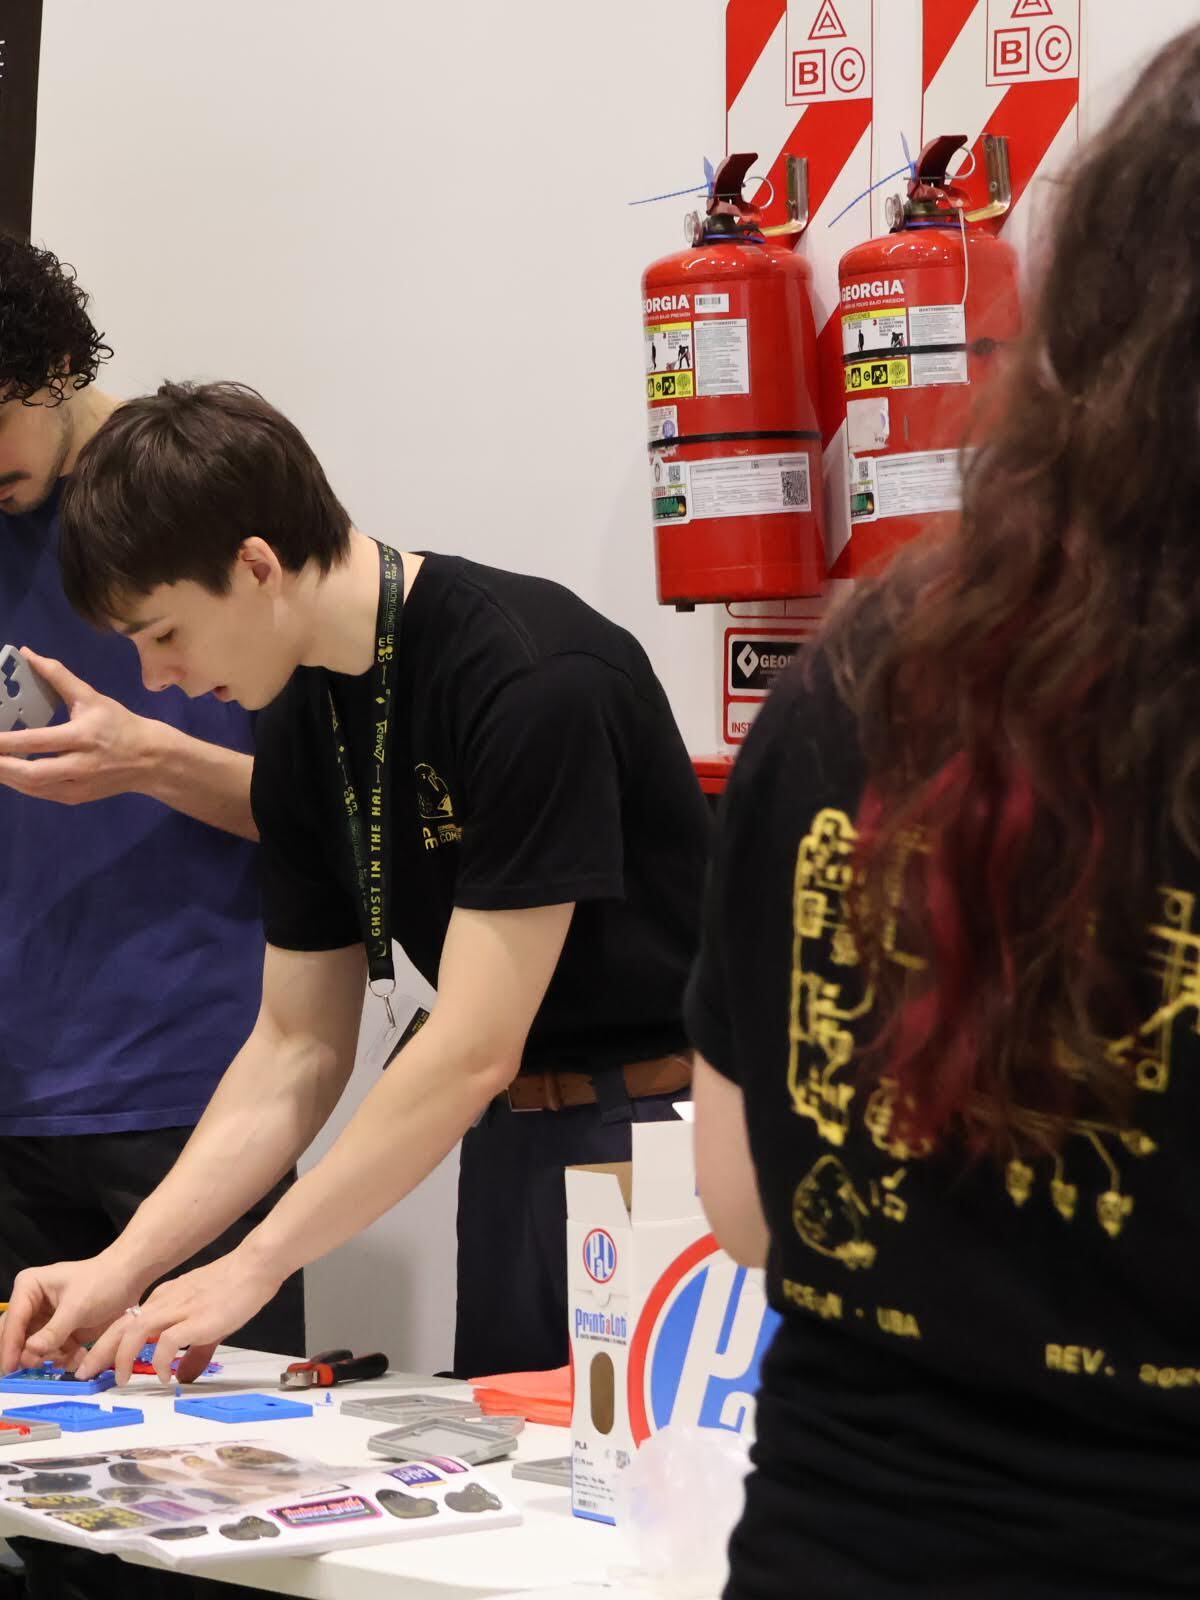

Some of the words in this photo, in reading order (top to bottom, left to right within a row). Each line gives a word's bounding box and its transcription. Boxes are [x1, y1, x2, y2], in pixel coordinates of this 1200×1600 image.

[818, 11, 838, 31] A
[1000, 40, 1021, 65] B
[1044, 37, 1062, 61] C
[799, 61, 820, 86] B
[839, 58, 857, 82] C
[642, 294, 690, 314] ORGIA
[842, 280, 904, 302] GEORGIA
[371, 786, 381, 816] HAL
[371, 824, 381, 852] THE
[371, 860, 381, 878] IN
[371, 886, 381, 937] GHOST
[1045, 1343, 1116, 1377] REV.
